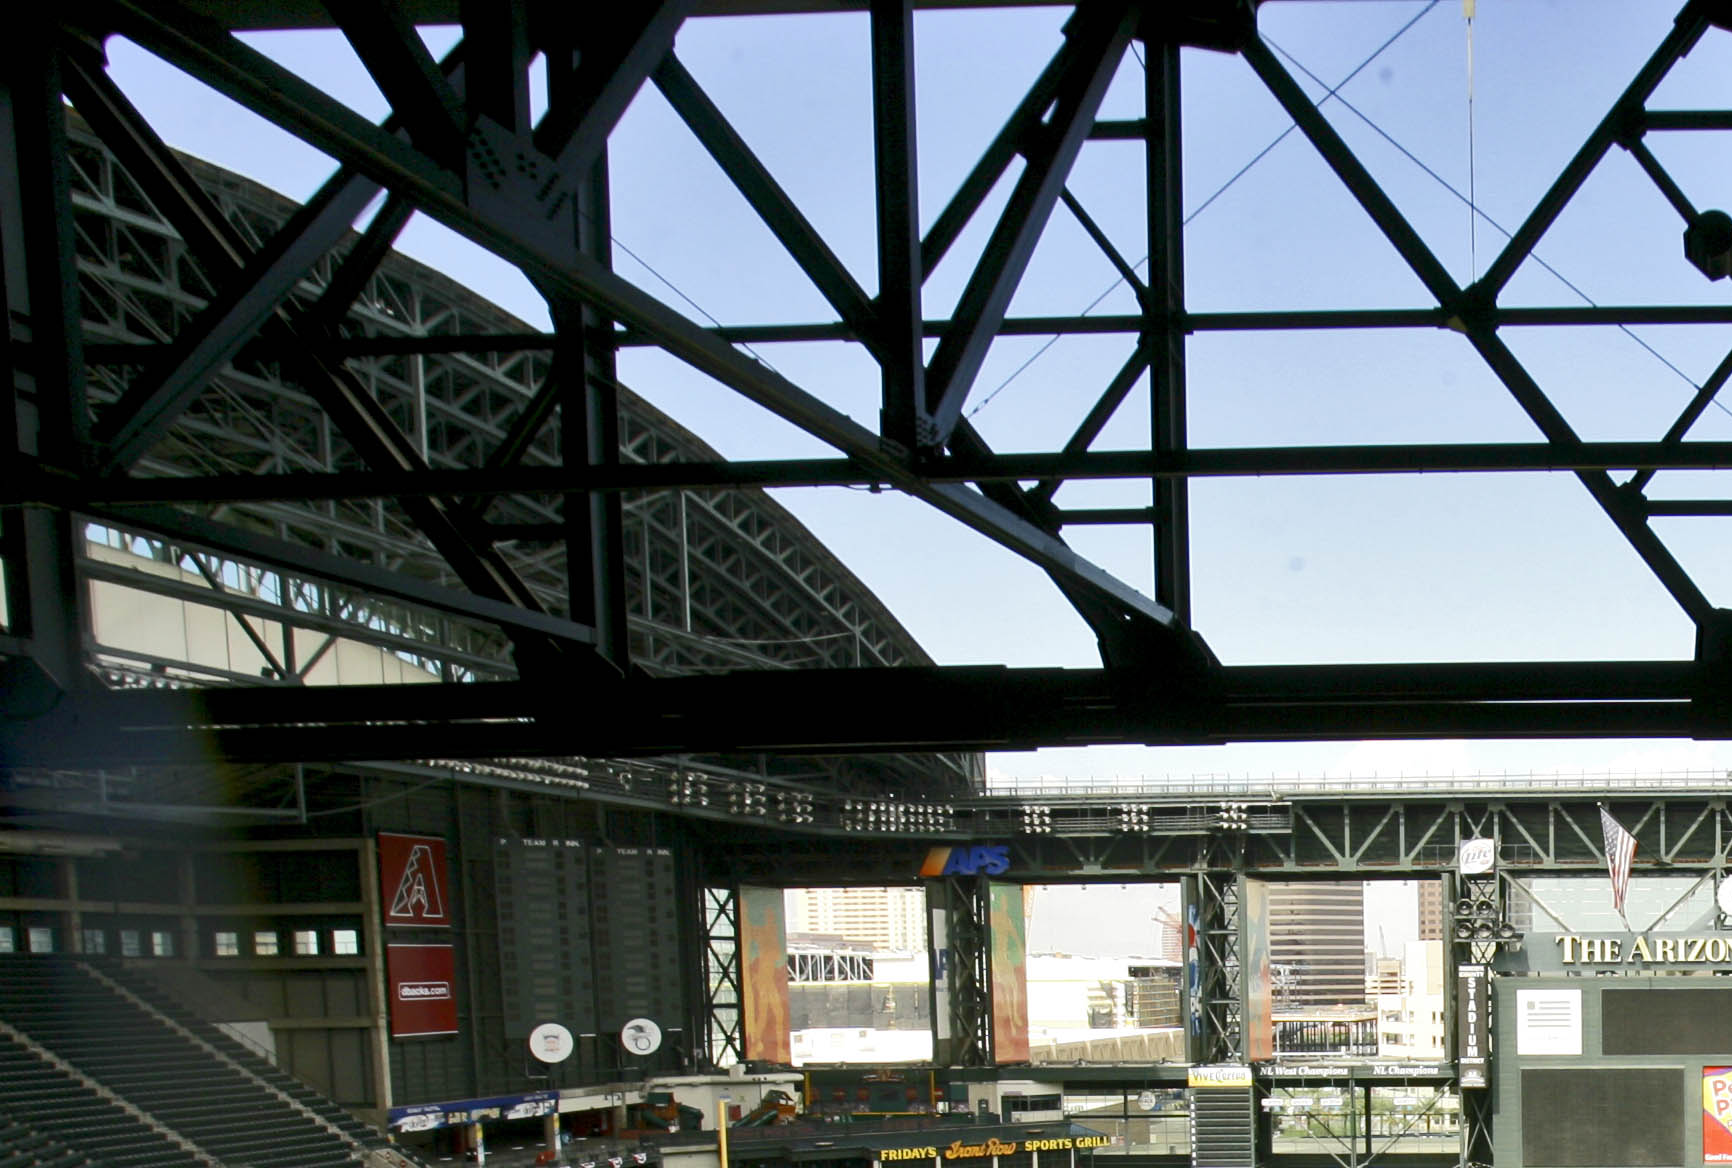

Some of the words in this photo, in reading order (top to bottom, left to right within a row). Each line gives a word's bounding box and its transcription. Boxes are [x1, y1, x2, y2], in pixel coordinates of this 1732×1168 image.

[944, 845, 1010, 876] APS
[1555, 935, 1622, 964] THE
[1467, 978, 1479, 1057] STADIUM
[1260, 1067, 1273, 1076] NL
[1275, 1066, 1297, 1076] West
[1298, 1066, 1349, 1078] Champions
[1373, 1066, 1386, 1075] NL
[1387, 1065, 1439, 1077] Champions
[880, 1146, 937, 1161] FRIDAY'S
[1025, 1138, 1072, 1152] SPORTS
[1076, 1136, 1110, 1148] GRILL
